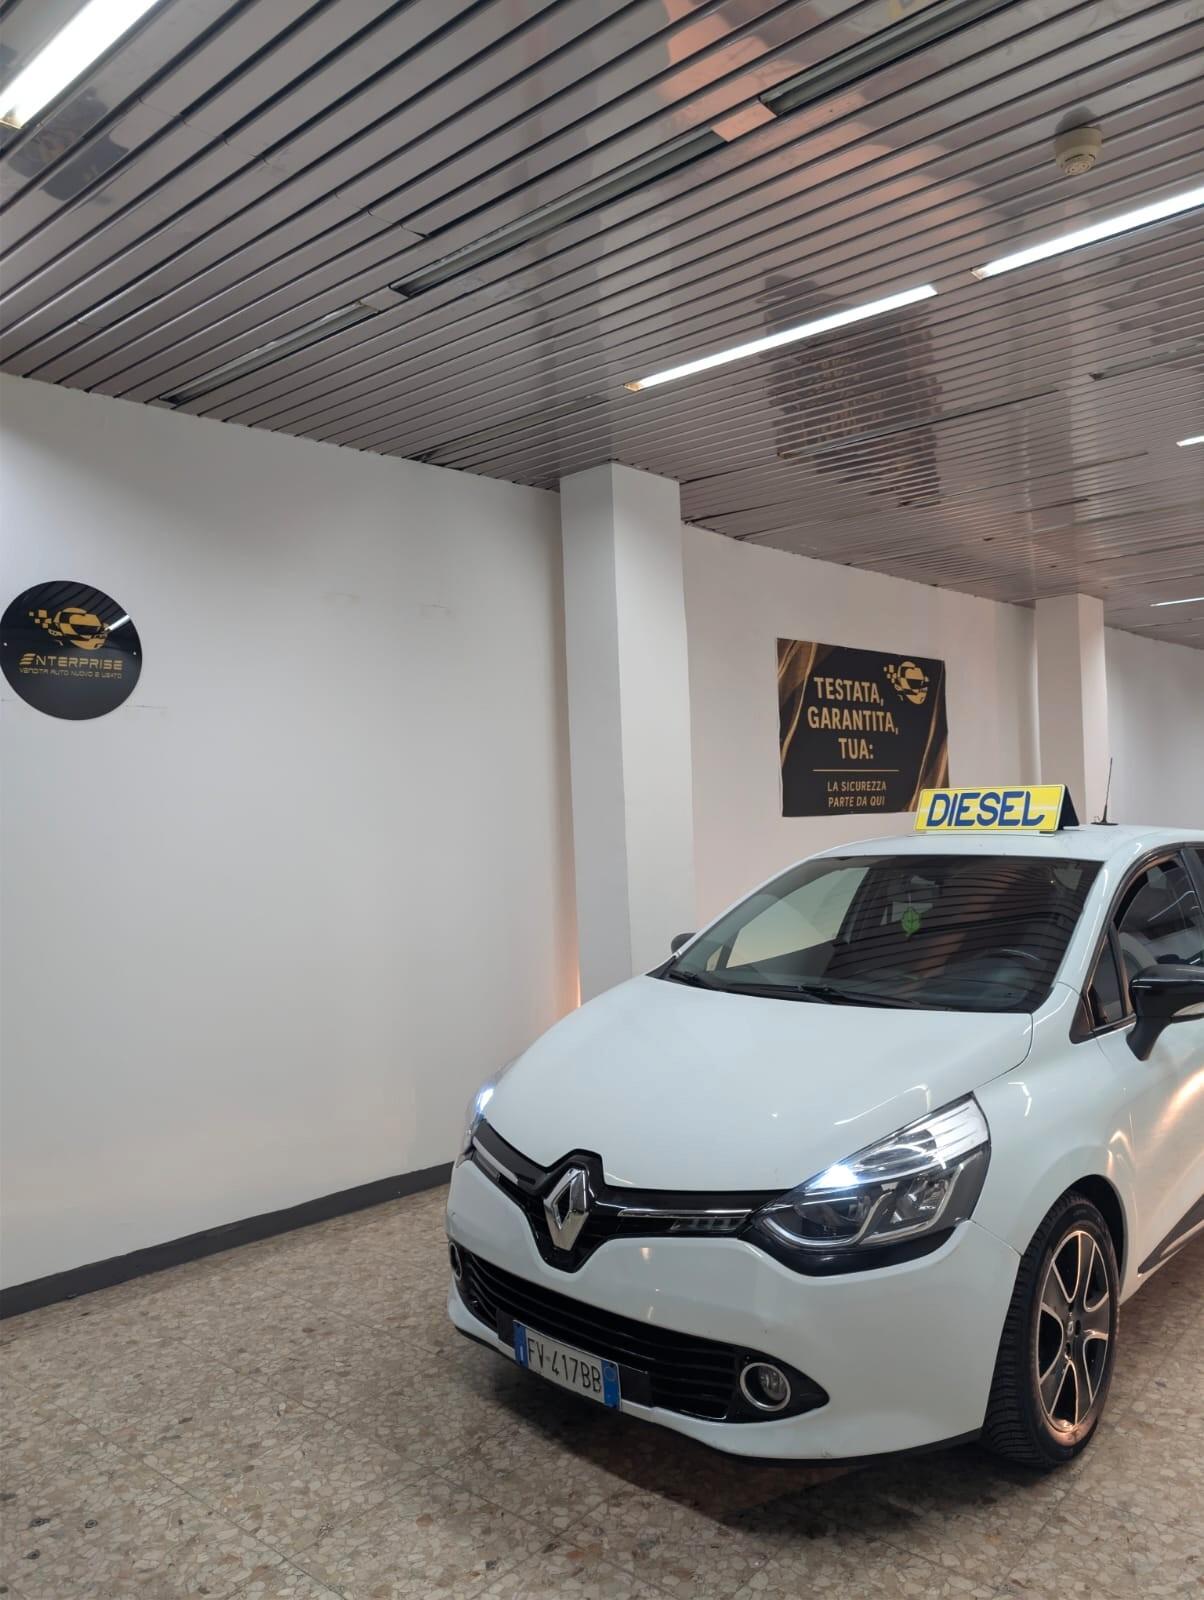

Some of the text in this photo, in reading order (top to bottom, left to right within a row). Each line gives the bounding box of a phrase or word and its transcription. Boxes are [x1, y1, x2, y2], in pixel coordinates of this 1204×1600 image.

[19, 653, 123, 671] ENTERPRISE
[813, 677, 884, 707] TESTATA,
[807, 706, 899, 735] GARANTITA,
[838, 738, 874, 760] TUA:
[827, 781, 887, 792] LA SICUREZZA
[828, 796, 885, 808] PARTE DA QUI
[926, 791, 1045, 827] DIESEL
